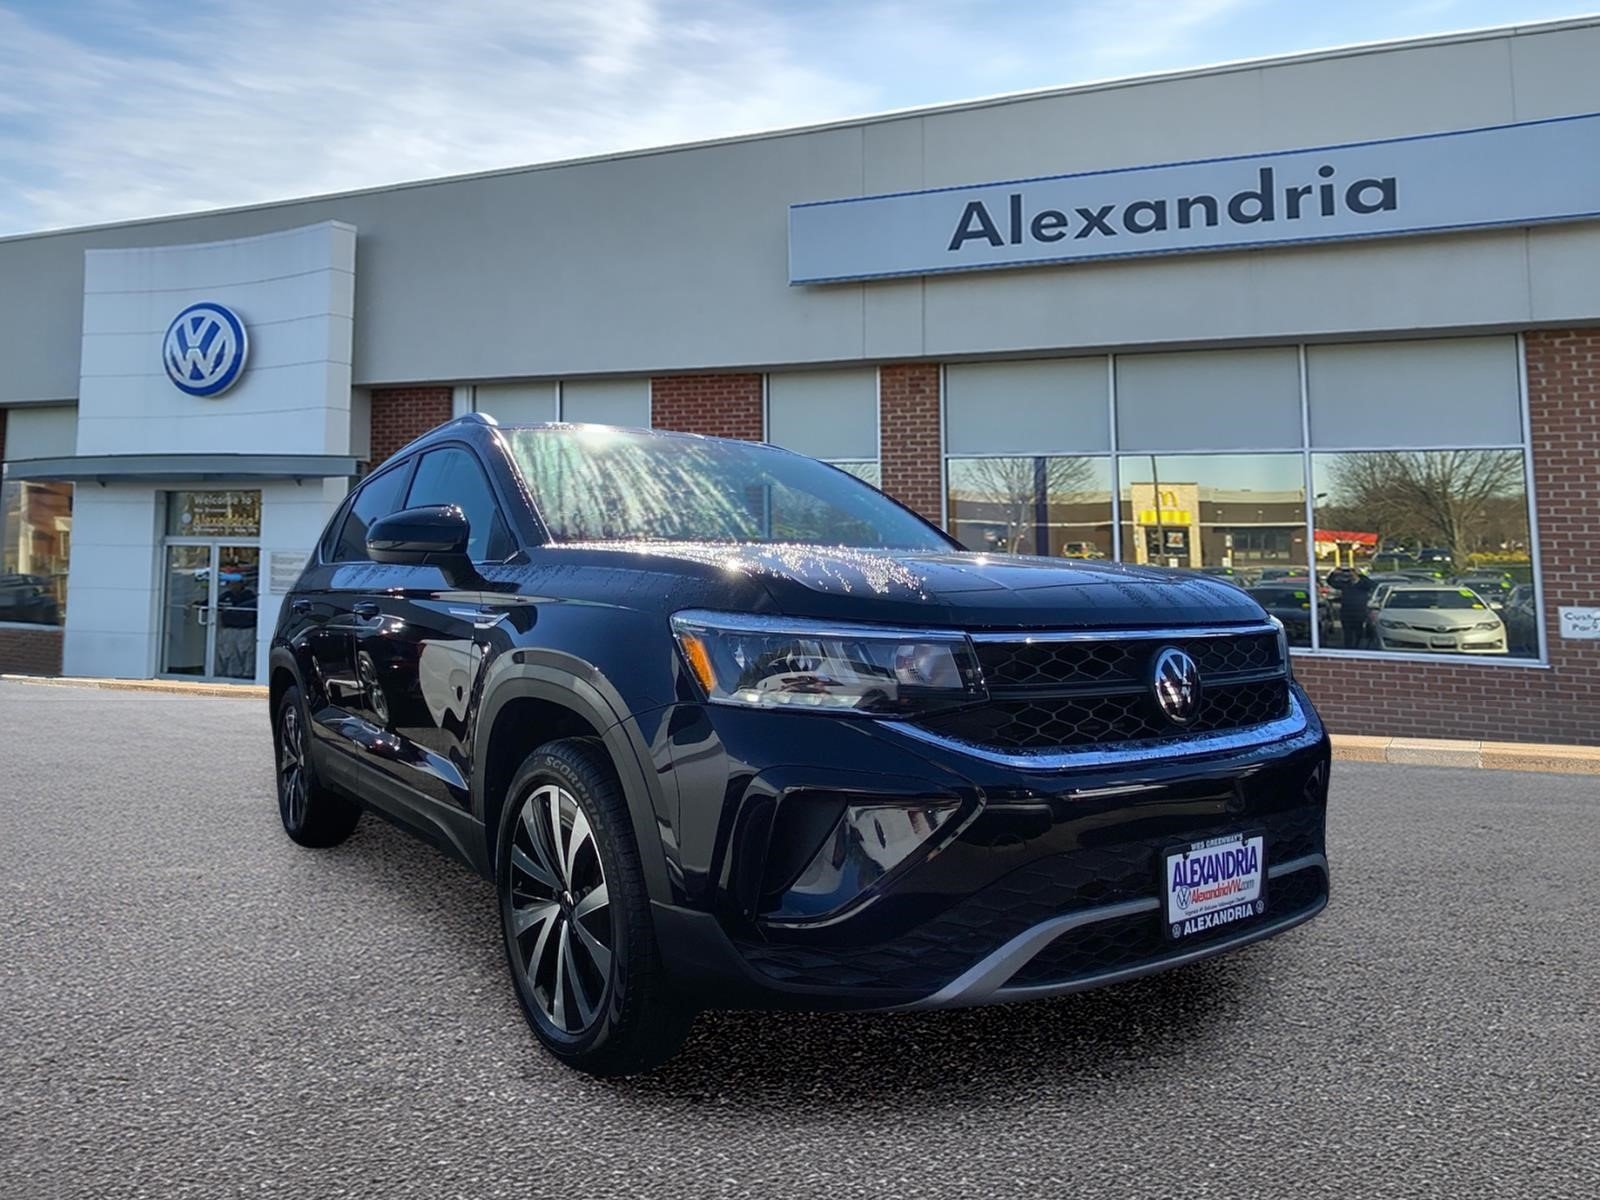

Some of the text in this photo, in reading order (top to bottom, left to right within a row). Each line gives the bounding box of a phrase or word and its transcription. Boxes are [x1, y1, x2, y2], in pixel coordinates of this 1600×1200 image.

[947, 164, 1398, 252] Alexandria
[545, 756, 604, 831] SCORPION
[1172, 846, 1258, 893] ALEXANDRIA
[1191, 878, 1255, 904] AlexandriaVW.com
[1184, 903, 1254, 936] ALEXANDRIA
